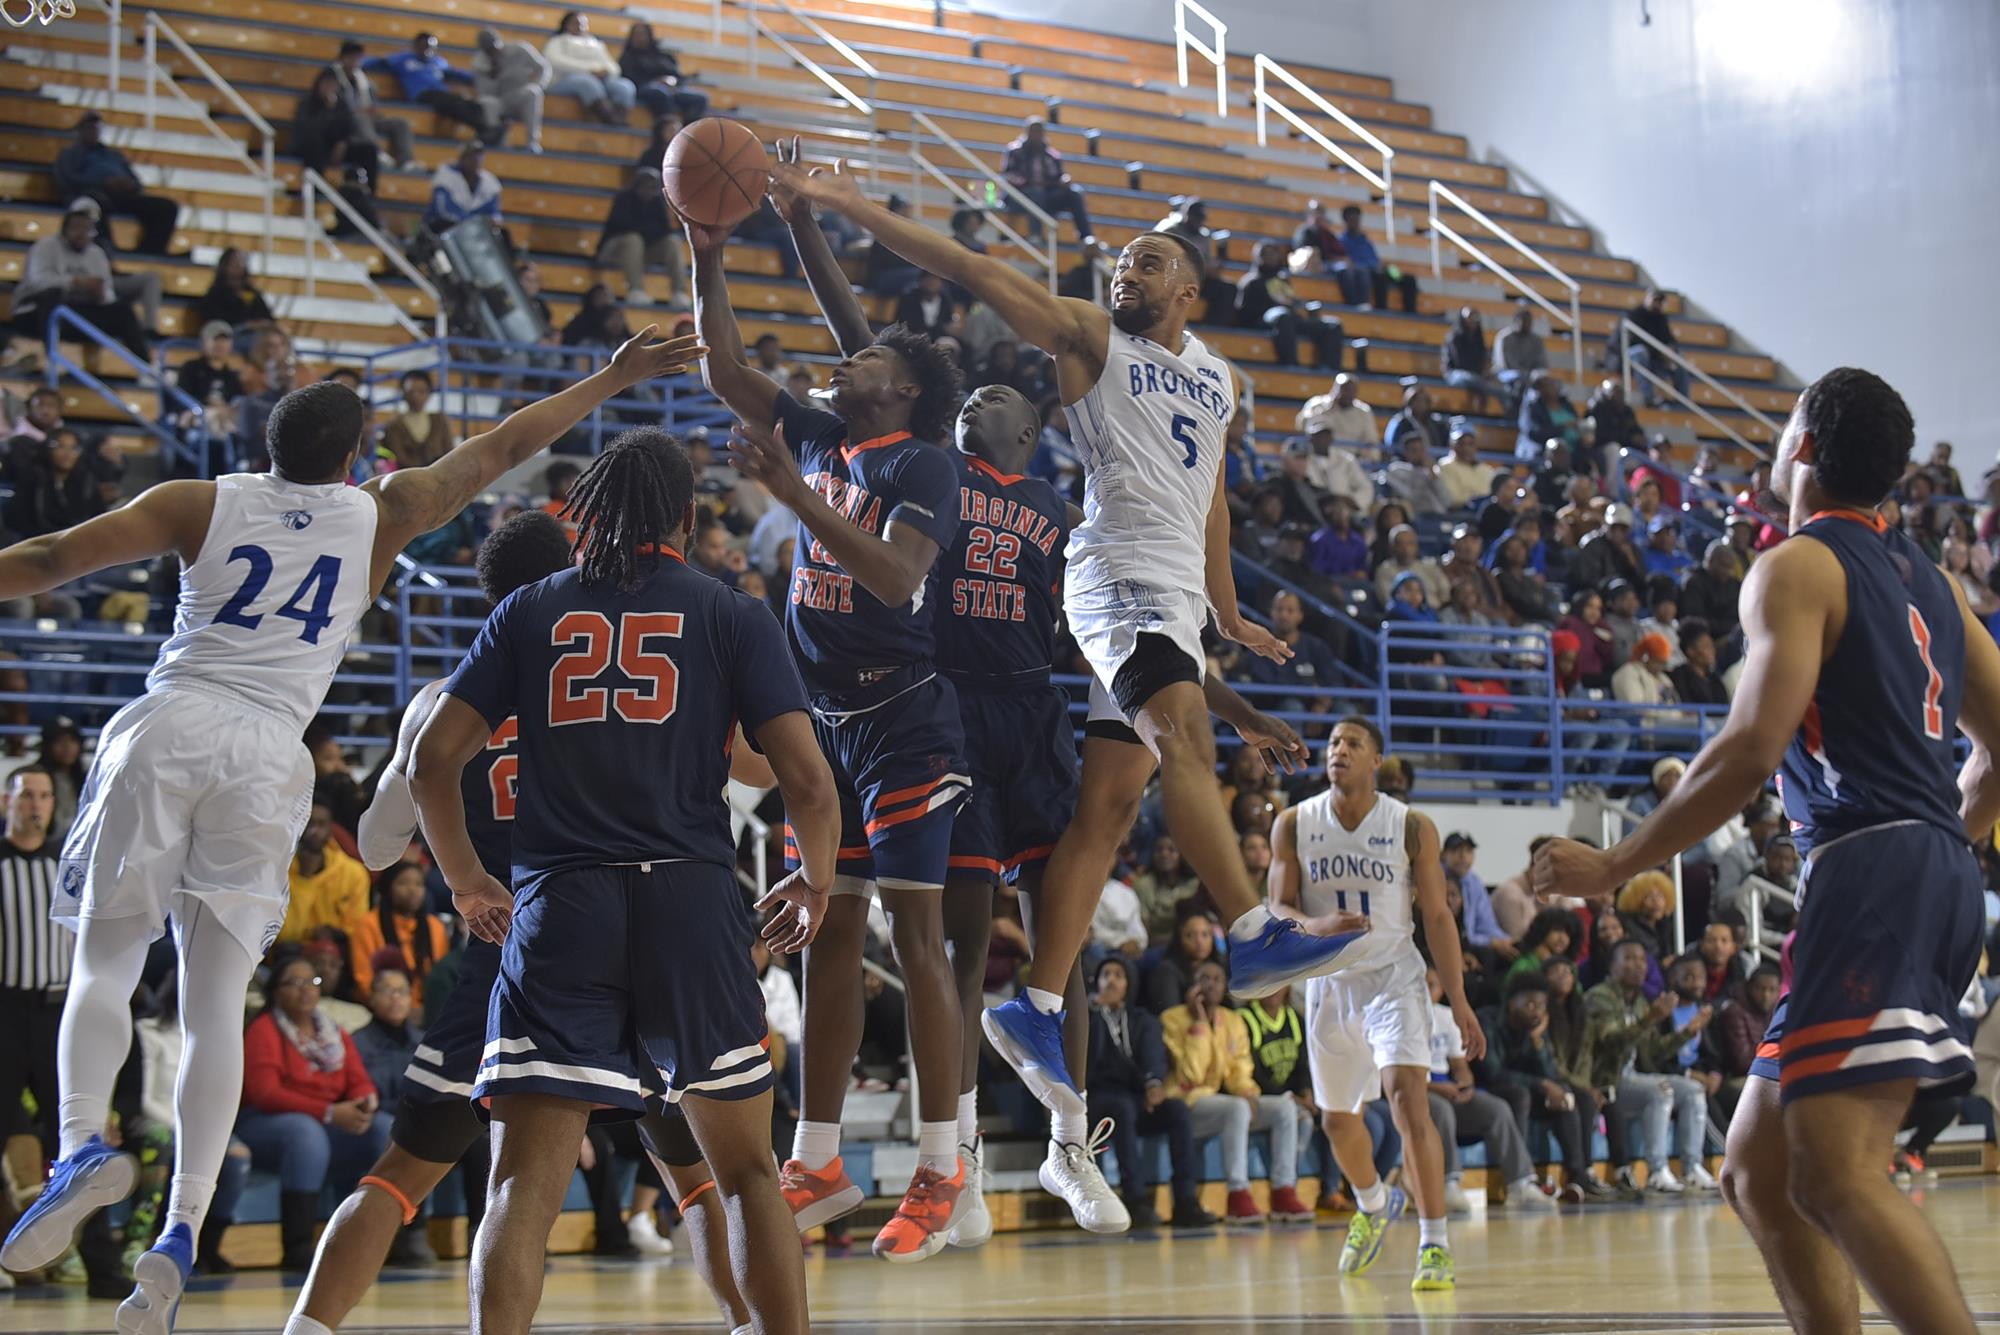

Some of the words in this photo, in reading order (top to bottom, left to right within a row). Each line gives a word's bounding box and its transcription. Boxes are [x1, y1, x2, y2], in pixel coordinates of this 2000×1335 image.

[1171, 413, 1198, 469] 5
[965, 526, 1021, 579] 22
[211, 544, 342, 646] 24
[792, 566, 853, 613] STATE
[952, 578, 1026, 621] STATE
[548, 611, 685, 727] 25
[1907, 603, 1943, 741] 1
[1310, 855, 1394, 884] BRONCOS
